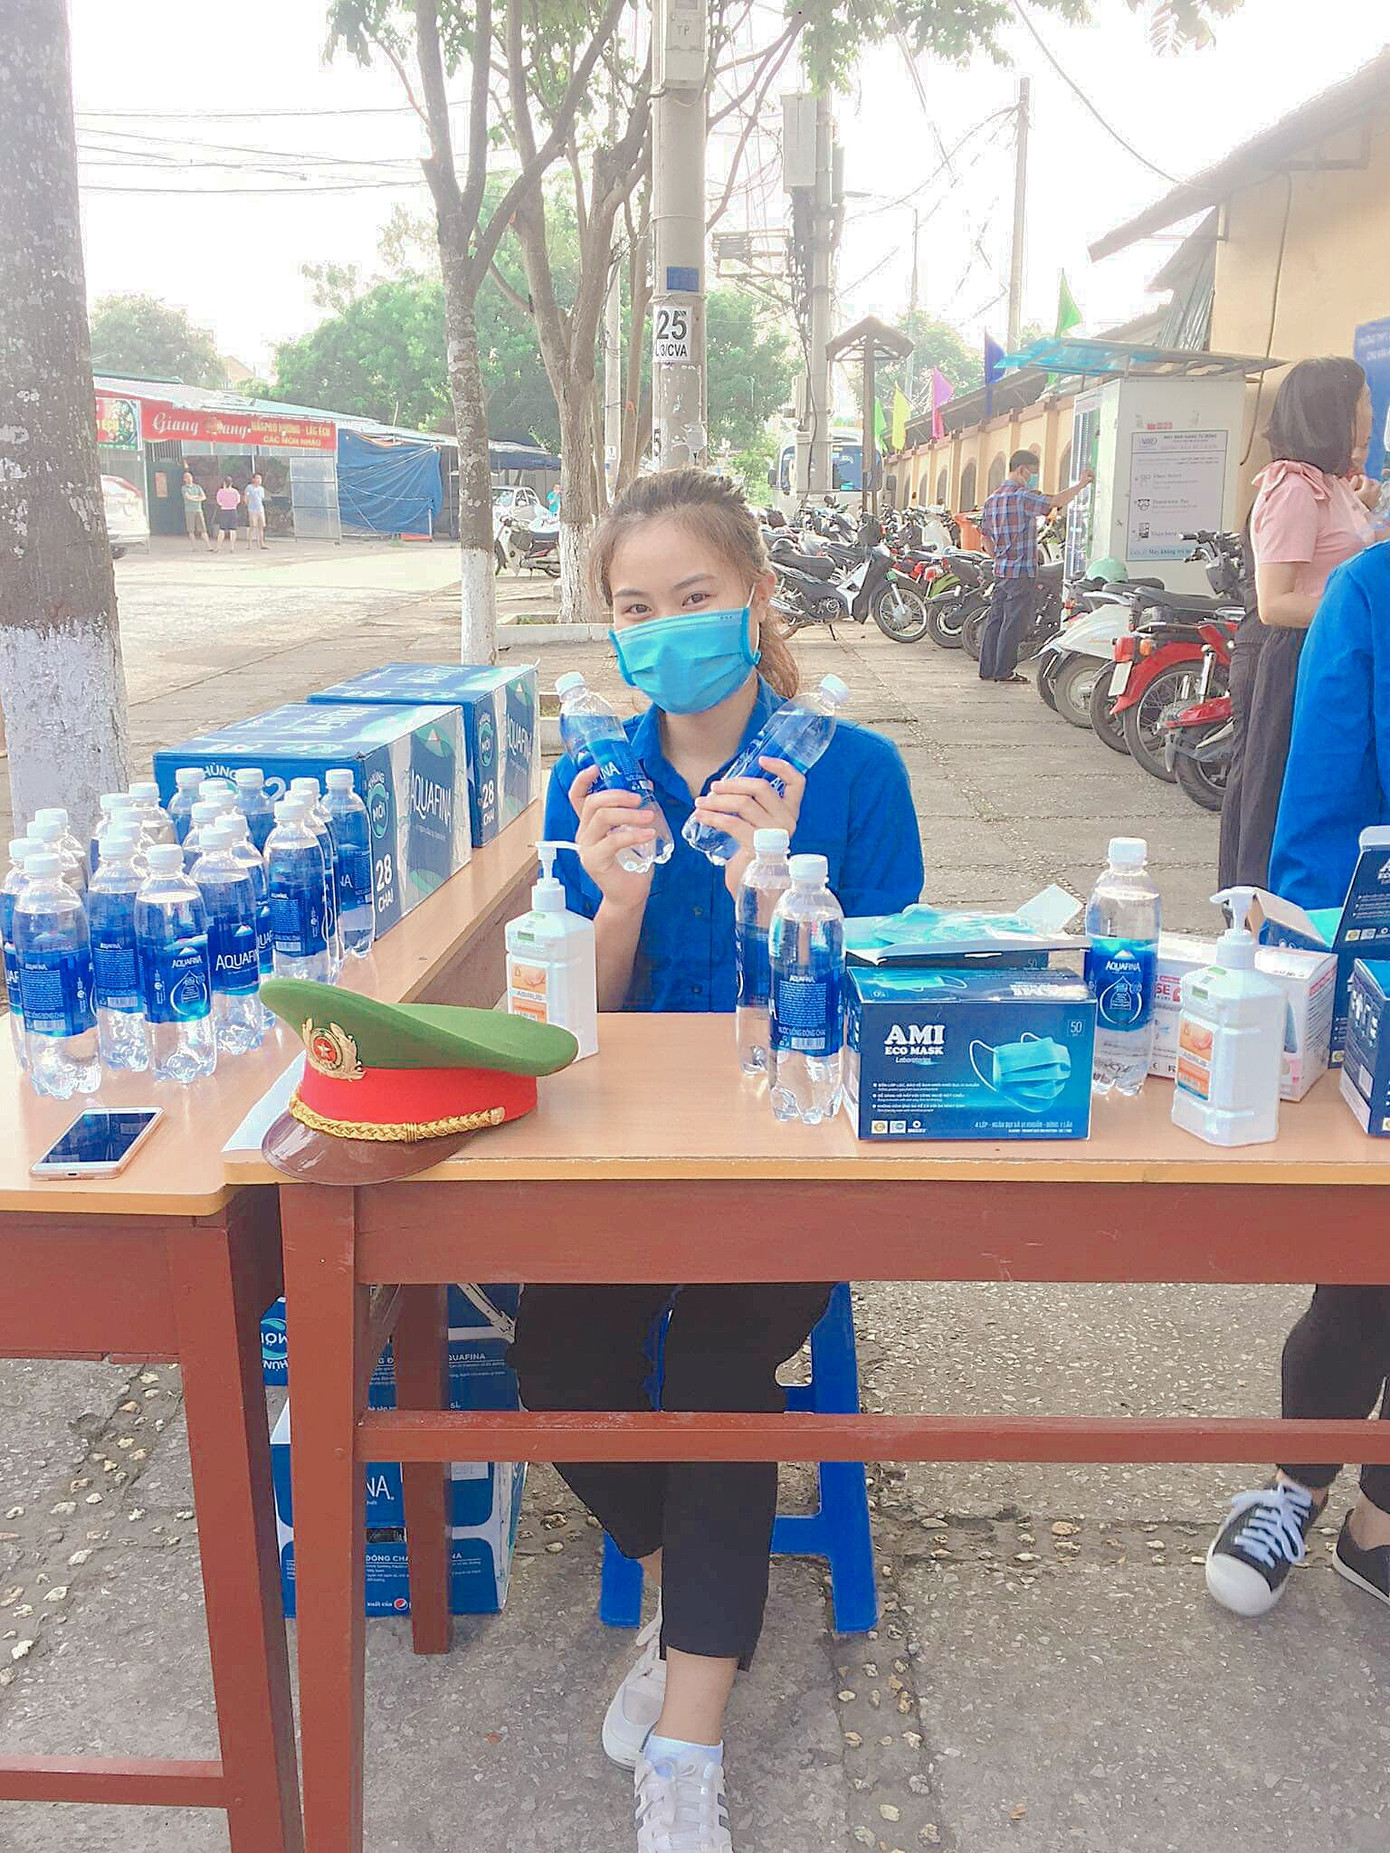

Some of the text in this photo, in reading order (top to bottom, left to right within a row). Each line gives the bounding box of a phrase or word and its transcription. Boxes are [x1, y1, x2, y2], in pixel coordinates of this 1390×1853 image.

[656, 310, 687, 340] 25
[203, 761, 237, 781] HÙNG
[482, 780, 494, 809] 28
[375, 853, 393, 891] 28
[378, 888, 394, 913] CHAI
[1105, 960, 1141, 972] AQUAFINA
[884, 1024, 945, 1045] AMI
[1070, 1021, 1083, 1034] 50
[885, 1046, 944, 1056] ECO MASK
